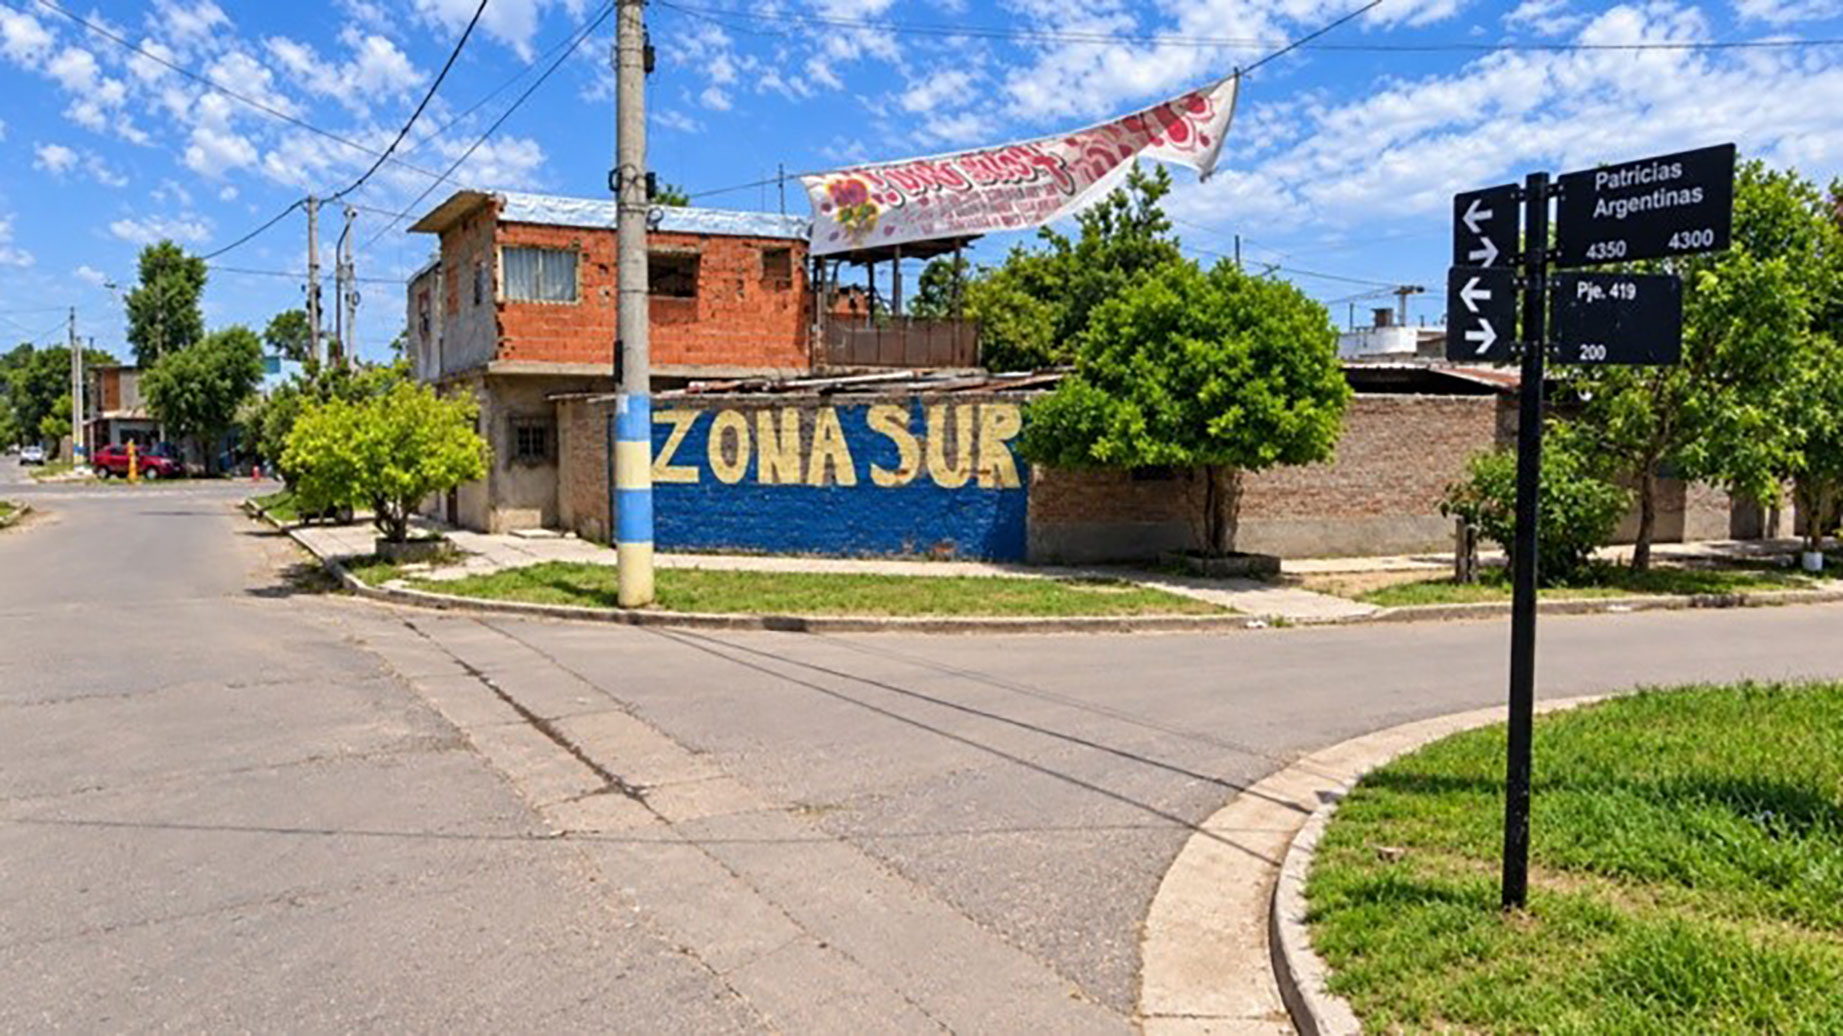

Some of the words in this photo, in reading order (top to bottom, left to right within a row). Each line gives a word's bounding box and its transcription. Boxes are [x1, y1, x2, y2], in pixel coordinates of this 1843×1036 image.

[1595, 161, 1683, 192] Patricias
[1592, 186, 1704, 220] Argentinas
[1585, 239, 1628, 260] 4350
[1667, 228, 1715, 250] 4300
[1577, 281, 1606, 303] Pje.
[1608, 283, 1637, 300] 419
[1579, 344, 1608, 361] 200
[652, 406, 858, 487] ZONA
[865, 403, 1023, 489] SUR
